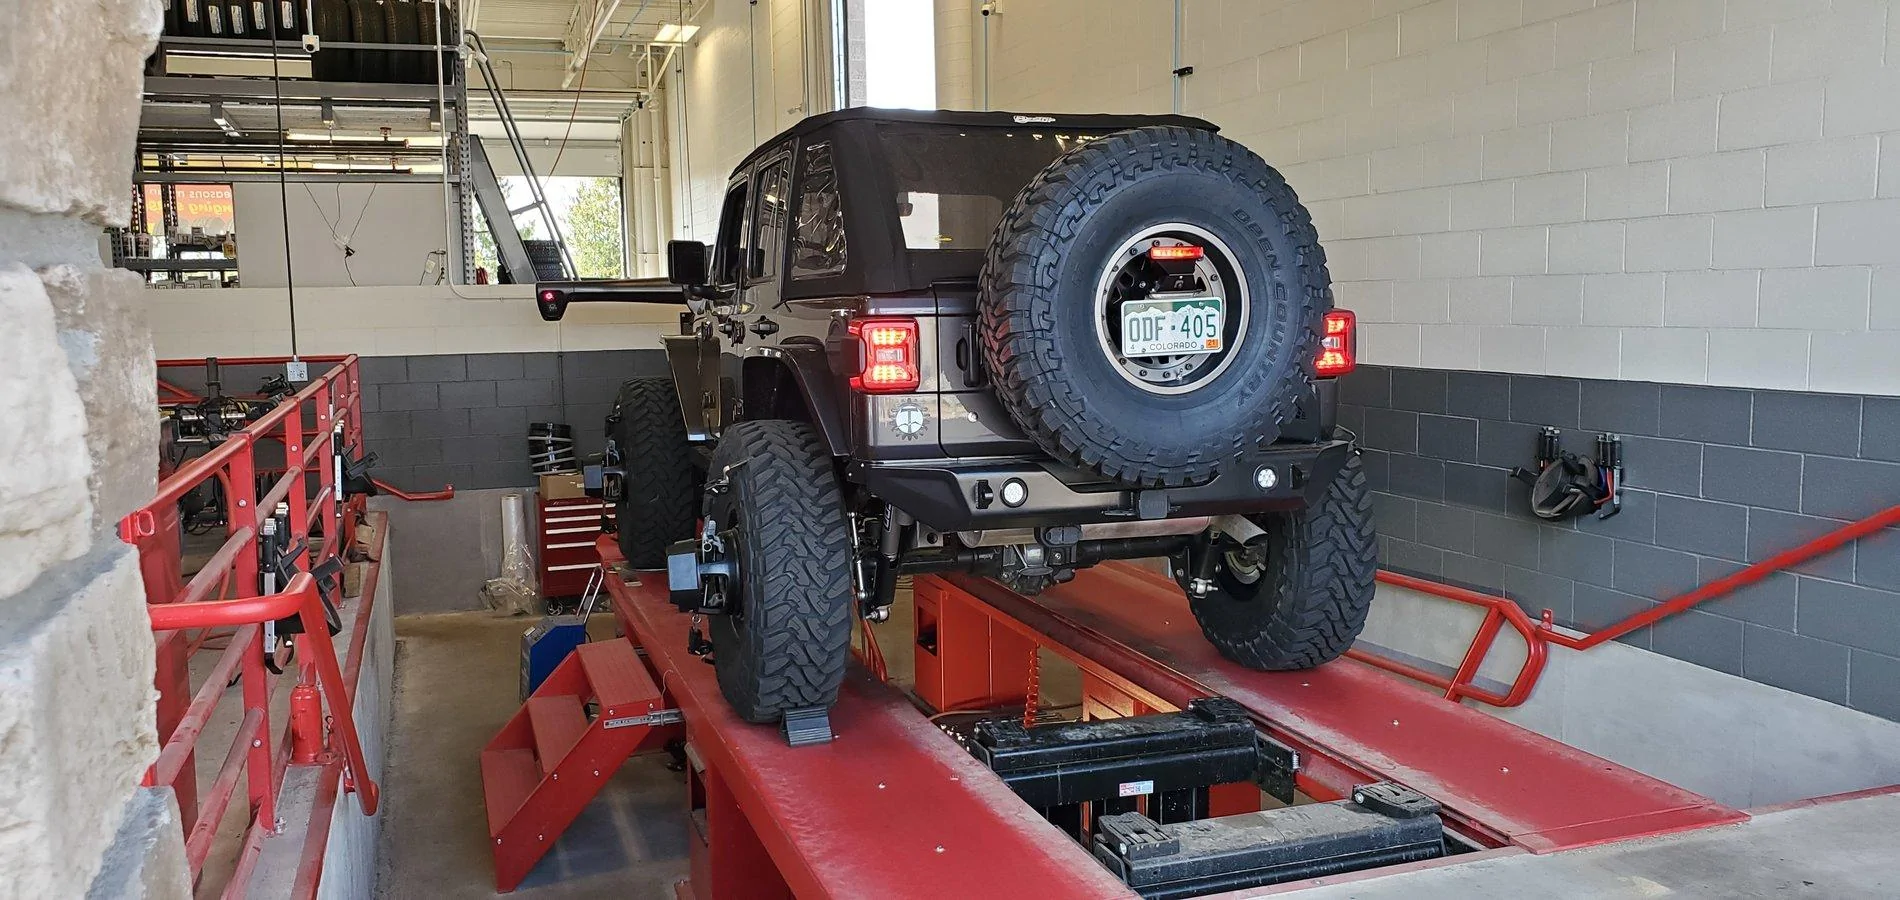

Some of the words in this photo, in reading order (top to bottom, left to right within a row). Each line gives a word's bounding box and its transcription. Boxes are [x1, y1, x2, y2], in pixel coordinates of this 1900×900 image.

[1232, 207, 1280, 274] OPEN
[1149, 341, 1198, 351] COLORADO
[1237, 282, 1288, 407] COUNTRY
